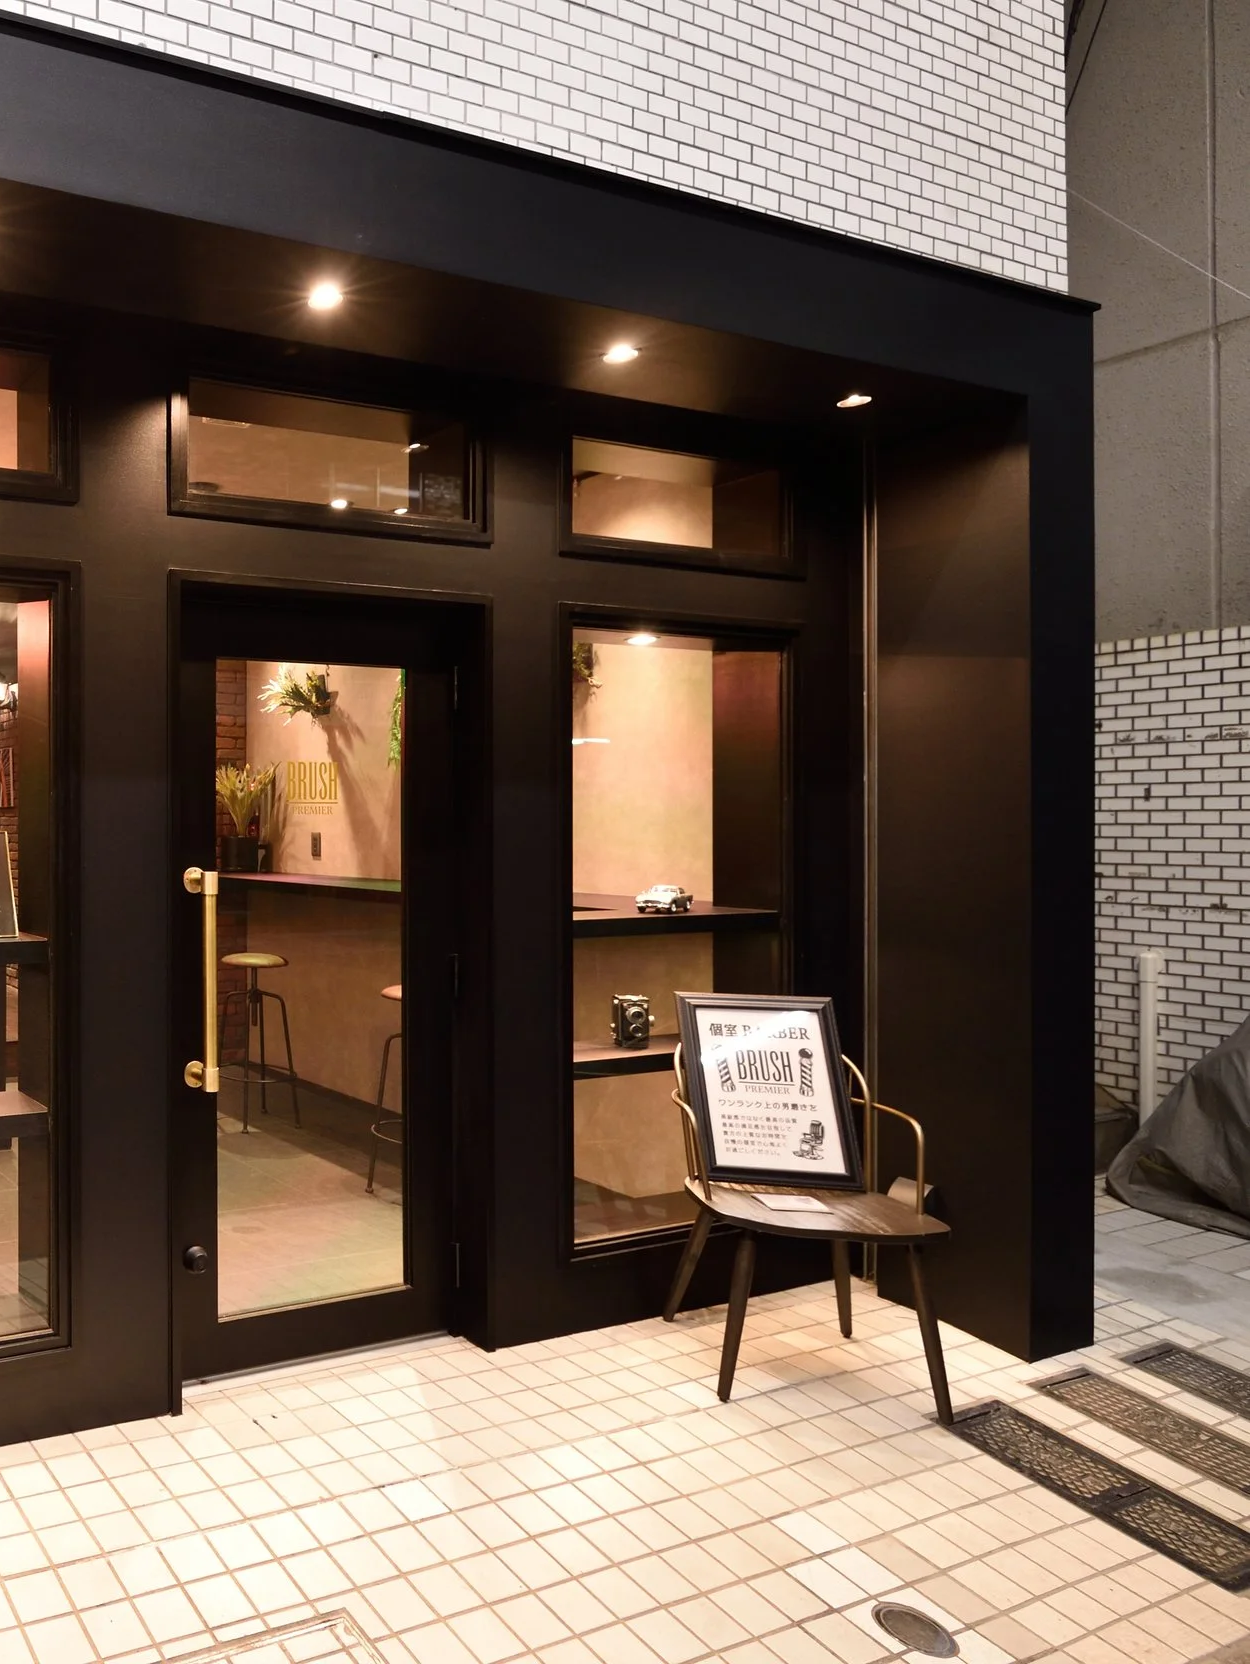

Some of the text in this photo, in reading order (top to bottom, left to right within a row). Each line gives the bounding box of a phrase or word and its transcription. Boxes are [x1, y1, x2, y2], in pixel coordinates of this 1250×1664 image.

[287, 761, 339, 800] BRUSH
[293, 806, 333, 815] PREMIER
[709, 1023, 738, 1037] 個室
[735, 1049, 794, 1083] BRUSH
[744, 1085, 791, 1095] PREMIER
